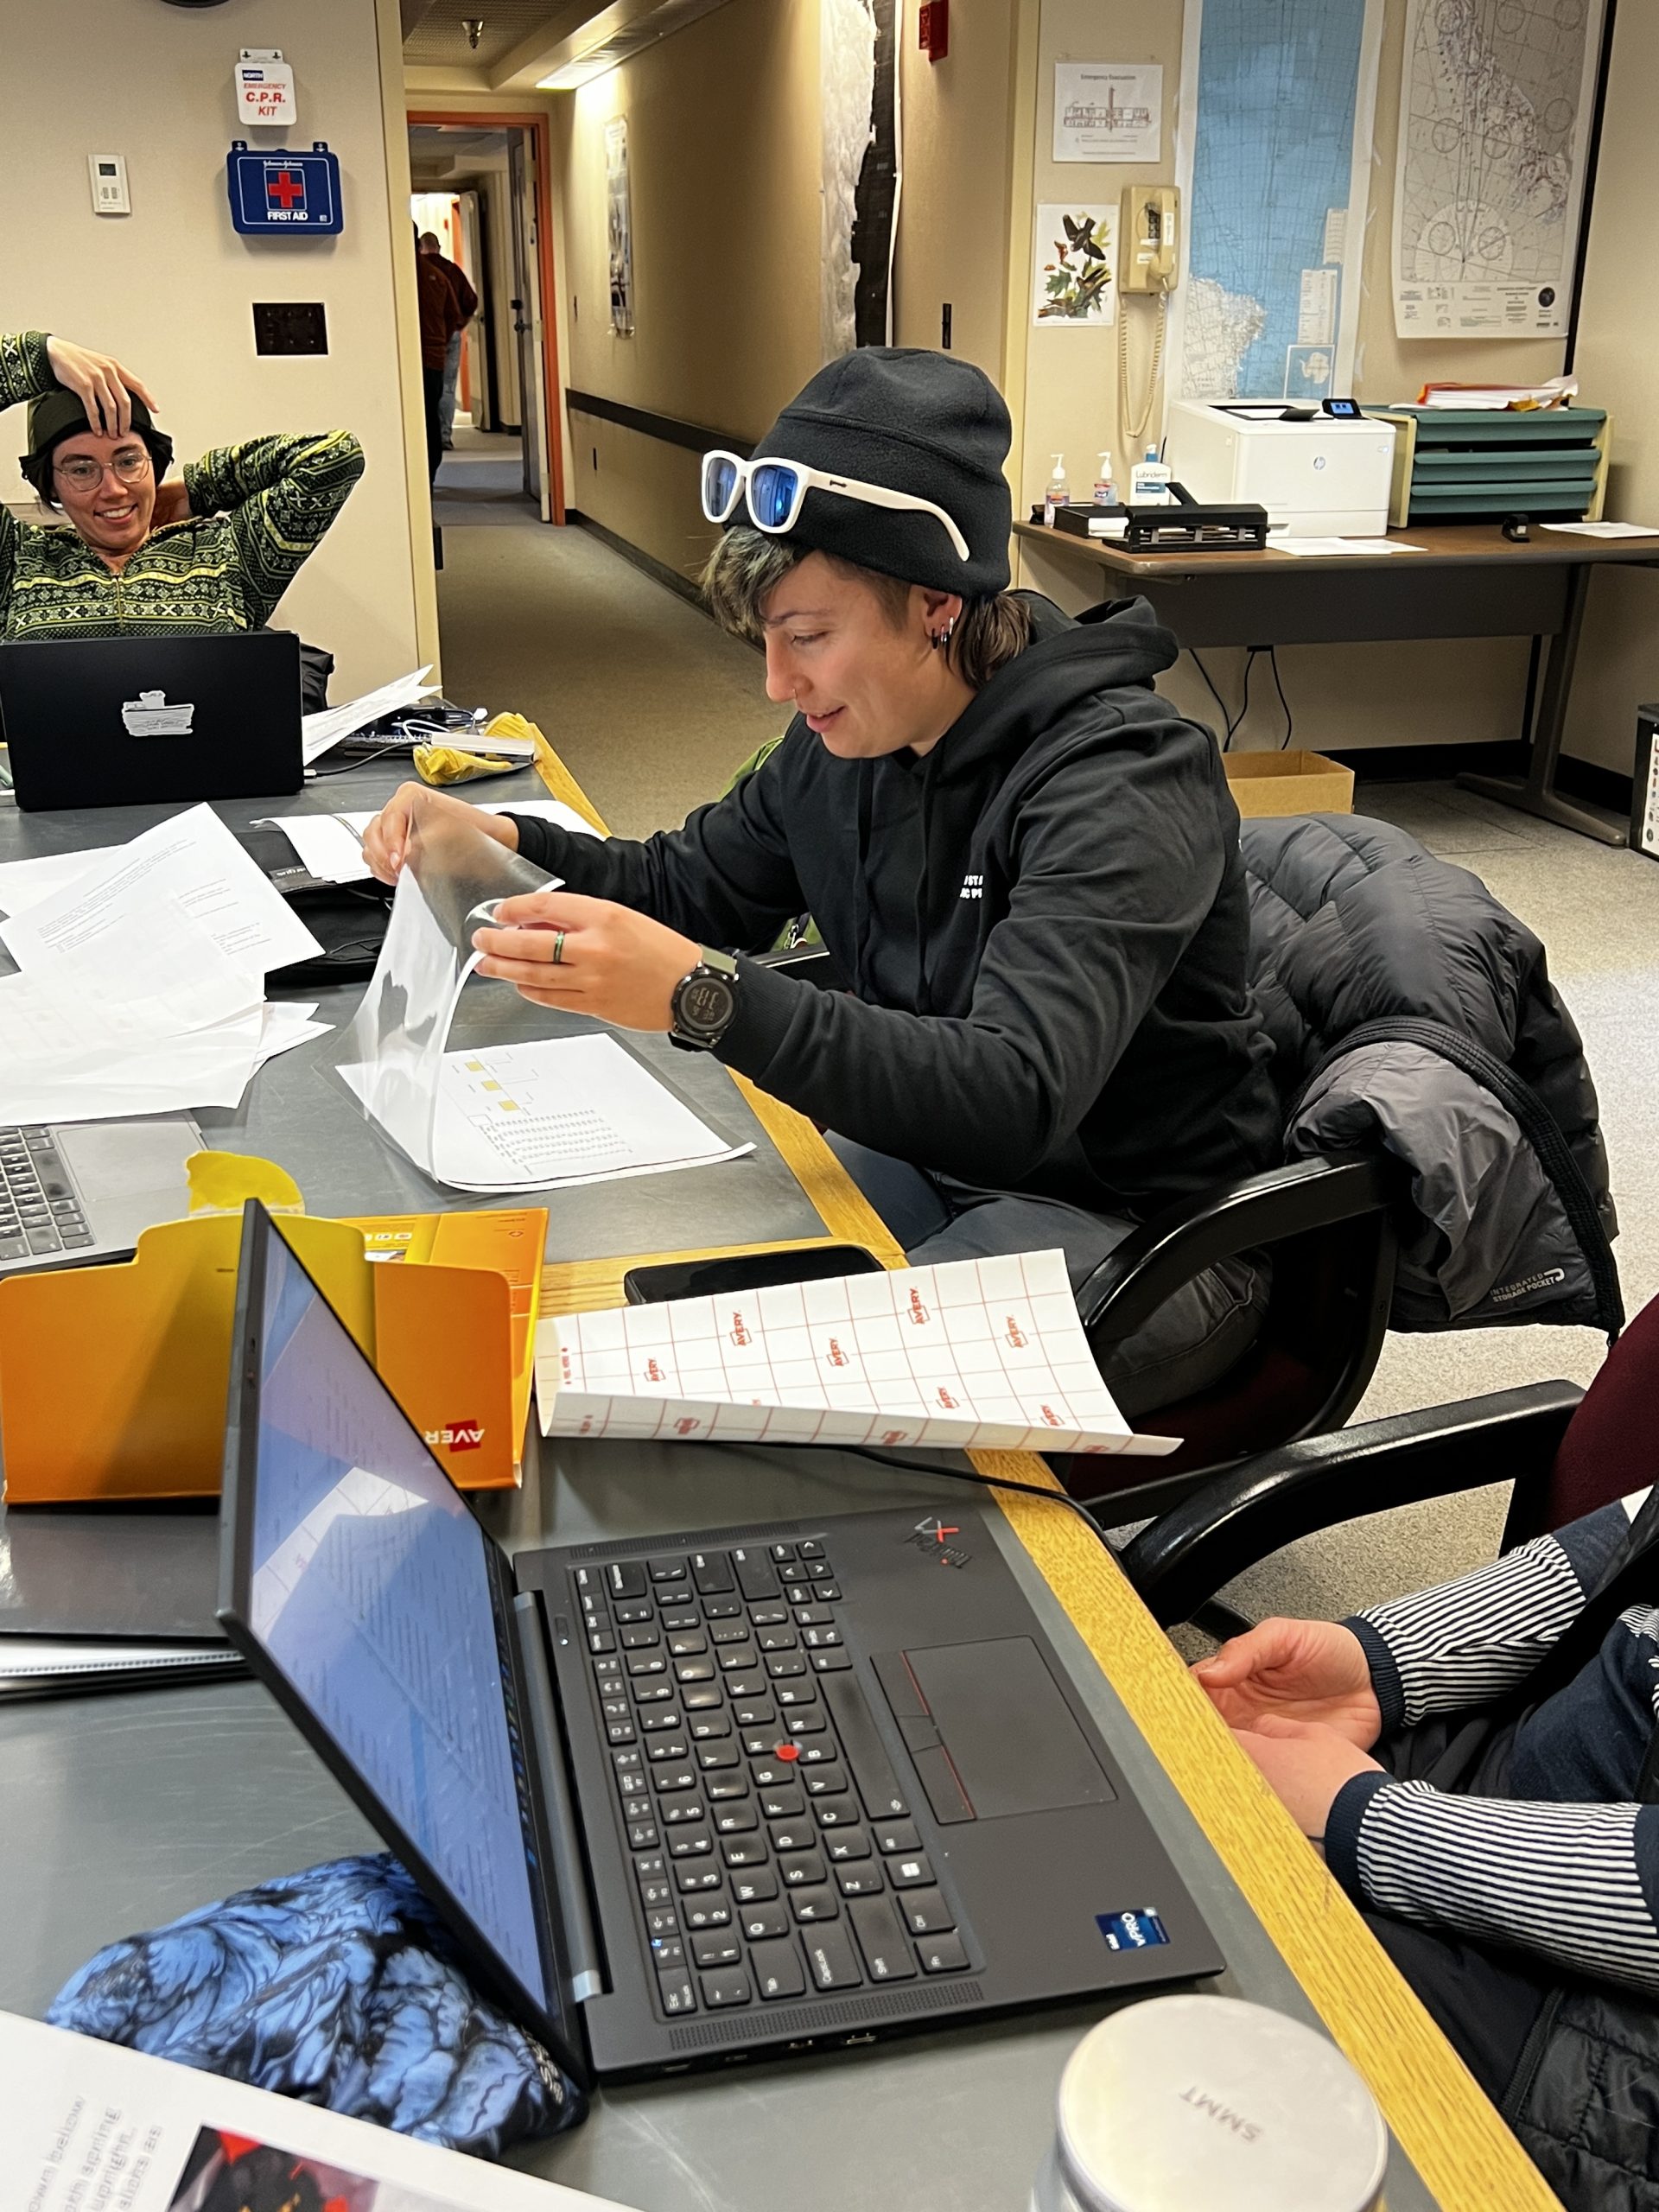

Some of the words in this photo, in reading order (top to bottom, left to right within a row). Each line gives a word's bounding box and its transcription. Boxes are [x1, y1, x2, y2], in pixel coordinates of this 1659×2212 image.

[246, 92, 286, 103] C.P.R.
[258, 106, 277, 116] KIT
[267, 212, 292, 220] FIRST
[292, 212, 308, 220] AID
[1490, 1273, 1544, 1296] INTEGRATED
[1492, 1287, 1527, 1302] STORAGE
[1526, 1276, 1555, 1292] POCKET
[909, 1287, 925, 1325] AVERY
[733, 1310, 747, 1346] AVERY
[1005, 1315, 1025, 1348] AVERY
[829, 1338, 844, 1367] AVERY
[423, 1428, 486, 1445] AVER
[733, 1684, 745, 1693] K
[781, 1691, 795, 1701] M
[663, 1715, 677, 1724] 8
[696, 1726, 710, 1734] U
[791, 1720, 804, 1730] N
[749, 1741, 763, 1750] H
[807, 1750, 821, 1759] B
[704, 1756, 718, 1764] Y
[677, 1775, 691, 1784] 6
[759, 1771, 772, 1782] G
[811, 1781, 825, 1790] V
[712, 1787, 727, 1796] T
[768, 1804, 782, 1813] F
[823, 1812, 836, 1822] C
[721, 1818, 734, 1827] R
[694, 1840, 708, 1849] 4
[779, 1836, 792, 1847] D
[834, 1846, 848, 1856] X
[731, 1852, 745, 1862] E
[702, 1873, 717, 1884] 3
[790, 1870, 804, 1880] S
[845, 1880, 861, 1890] Z
[739, 1885, 754, 1900] W
[712, 1910, 727, 1920] 2
[799, 1905, 815, 1917] A
[749, 1923, 765, 1936] Q
[814, 1948, 833, 1985] CapsLock
[874, 1957, 887, 1976] Shift
[766, 1977, 779, 1993] Tab
[668, 1993, 680, 2010] Esc
[1178, 2085, 1264, 2144] SMMT
